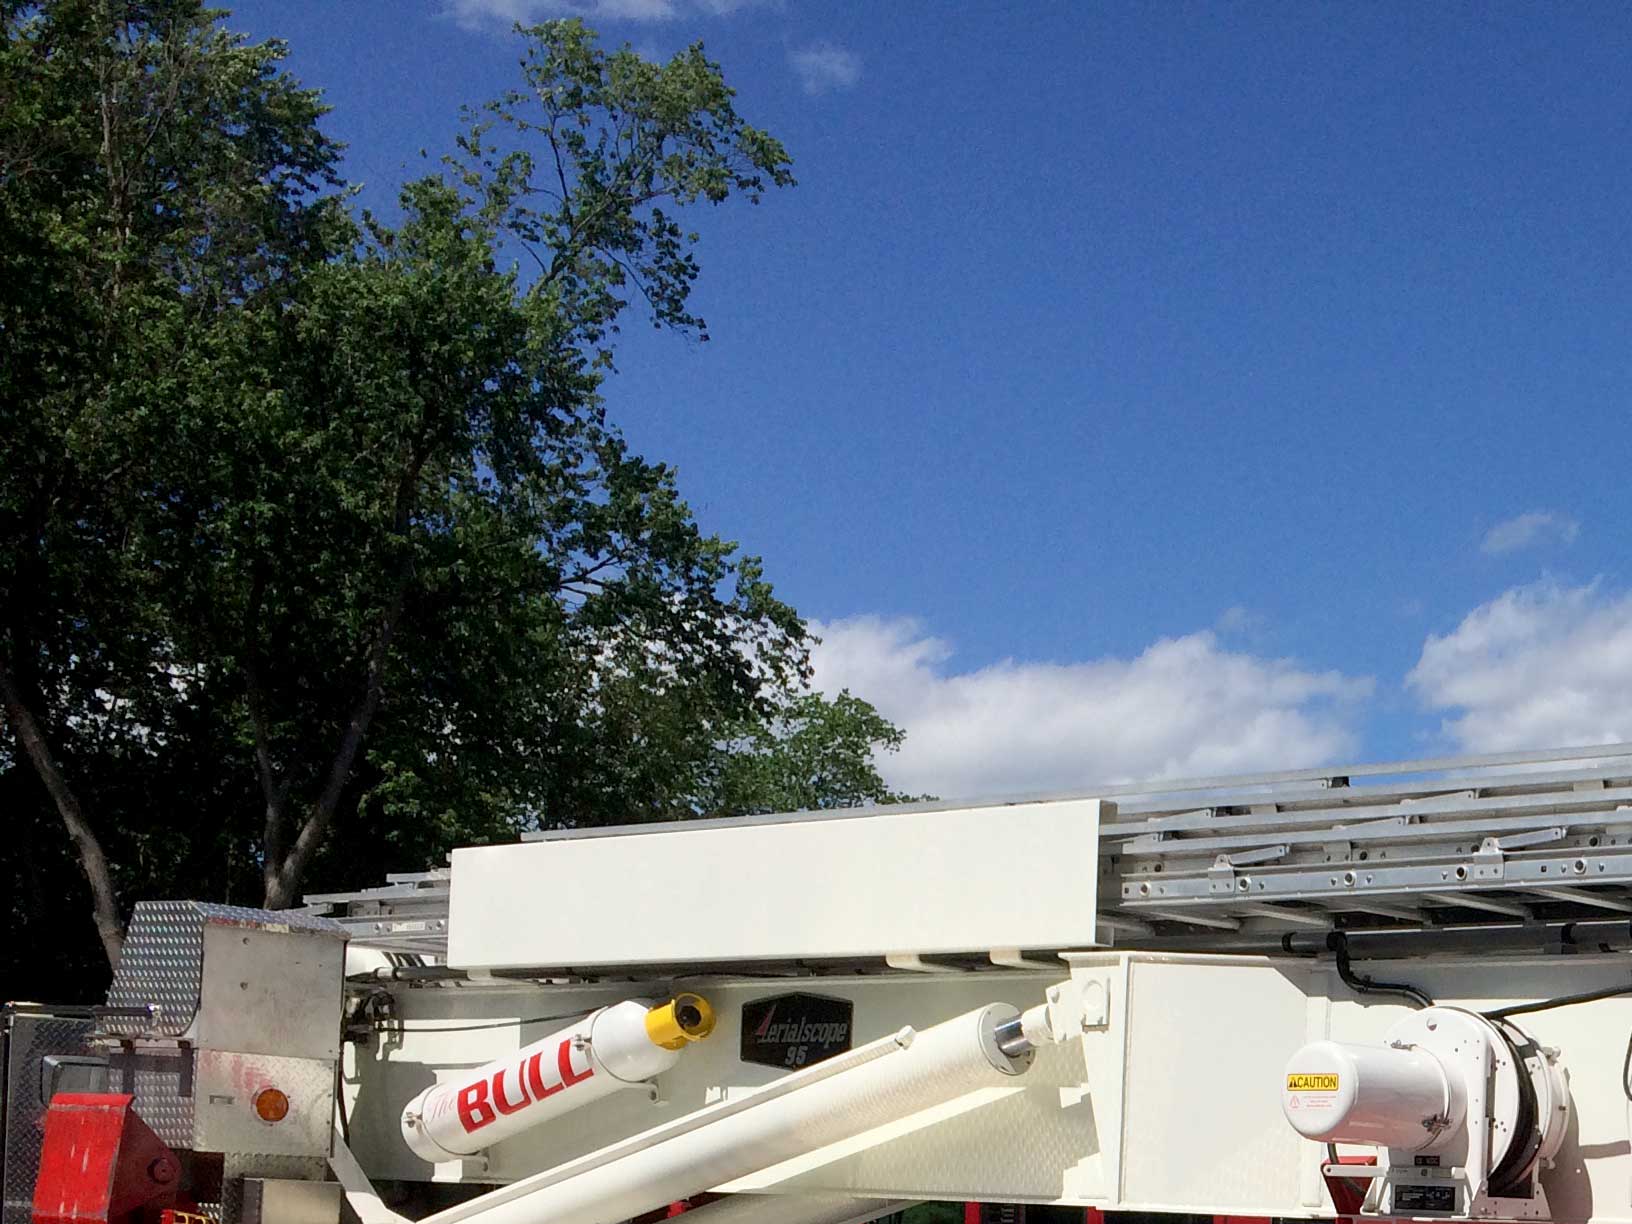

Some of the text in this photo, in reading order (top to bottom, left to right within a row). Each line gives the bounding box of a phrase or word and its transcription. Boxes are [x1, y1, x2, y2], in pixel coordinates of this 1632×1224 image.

[784, 1045, 809, 1065] 95
[457, 1039, 594, 1134] BULL
[1297, 1076, 1337, 1088] CAUTION
